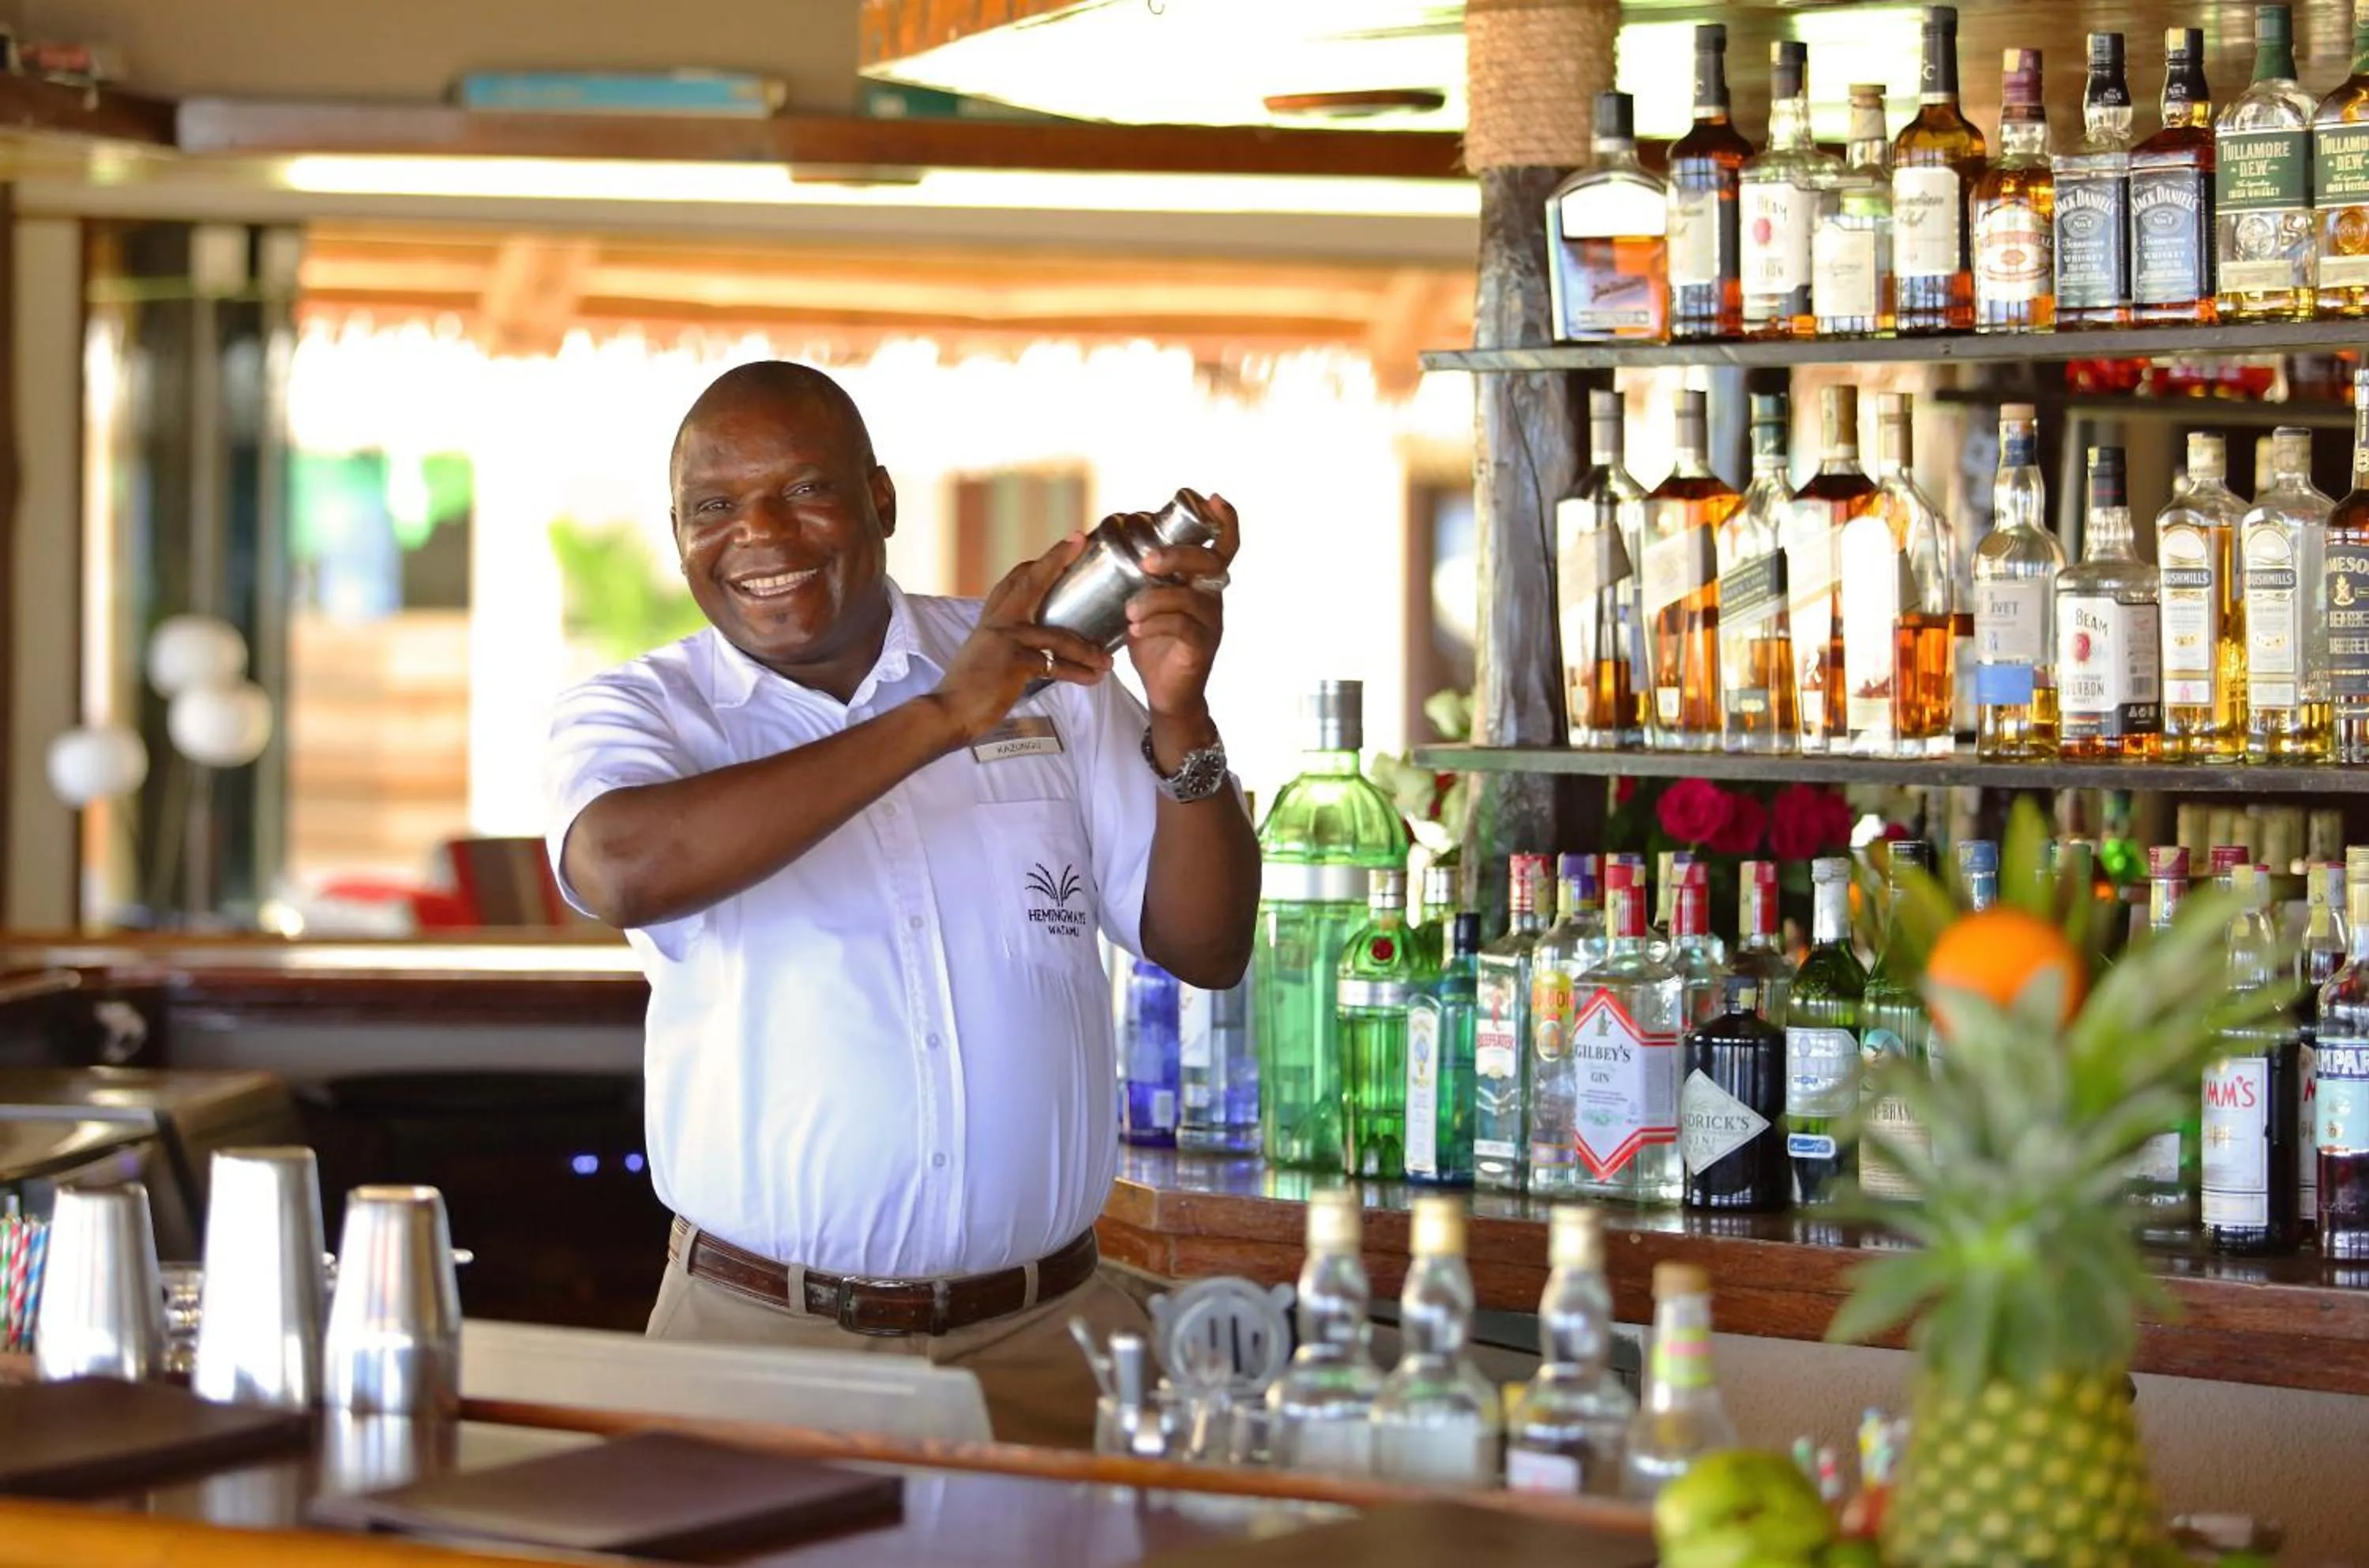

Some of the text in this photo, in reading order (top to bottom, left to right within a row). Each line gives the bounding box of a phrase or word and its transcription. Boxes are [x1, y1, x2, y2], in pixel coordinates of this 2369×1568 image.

[2221, 141, 2290, 162] TULLAMORE
[2163, 572, 2209, 585] USHMILLS
[2075, 607, 2108, 637] BEAM
[1028, 909, 1087, 925] HEMINGWAYS
[1575, 1044, 1631, 1063] GILBEY'S
[1590, 1071, 1610, 1083] GIN
[2204, 1075, 2256, 1108] MM'S
